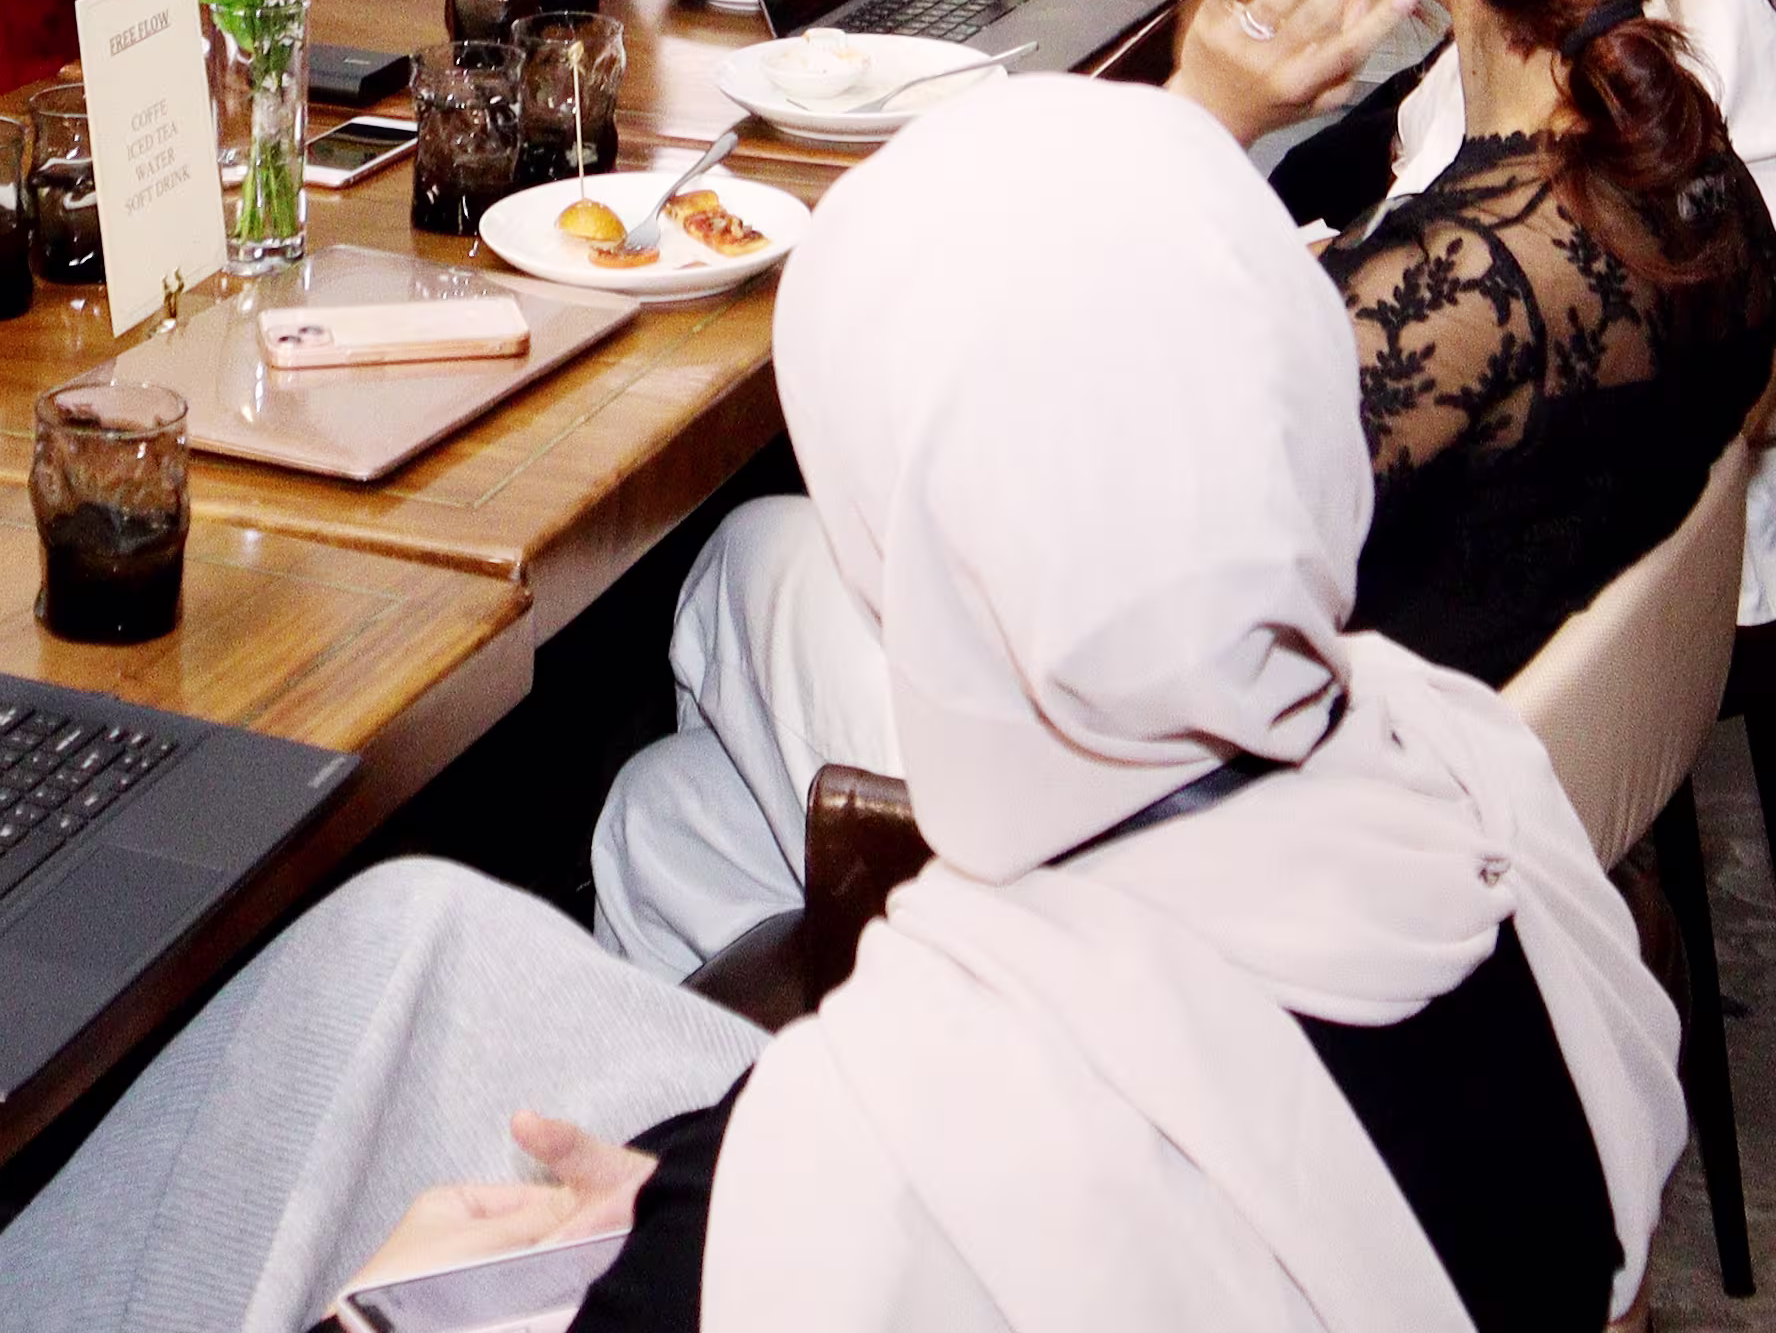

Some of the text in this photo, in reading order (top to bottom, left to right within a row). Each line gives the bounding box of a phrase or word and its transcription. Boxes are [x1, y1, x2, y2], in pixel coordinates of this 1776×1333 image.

[109, 9, 170, 55] FREE FLOW
[130, 99, 168, 132] COFFE
[126, 121, 179, 162] ICED TEA
[134, 146, 176, 182] WATER
[124, 164, 192, 216] SOFT DRINK
